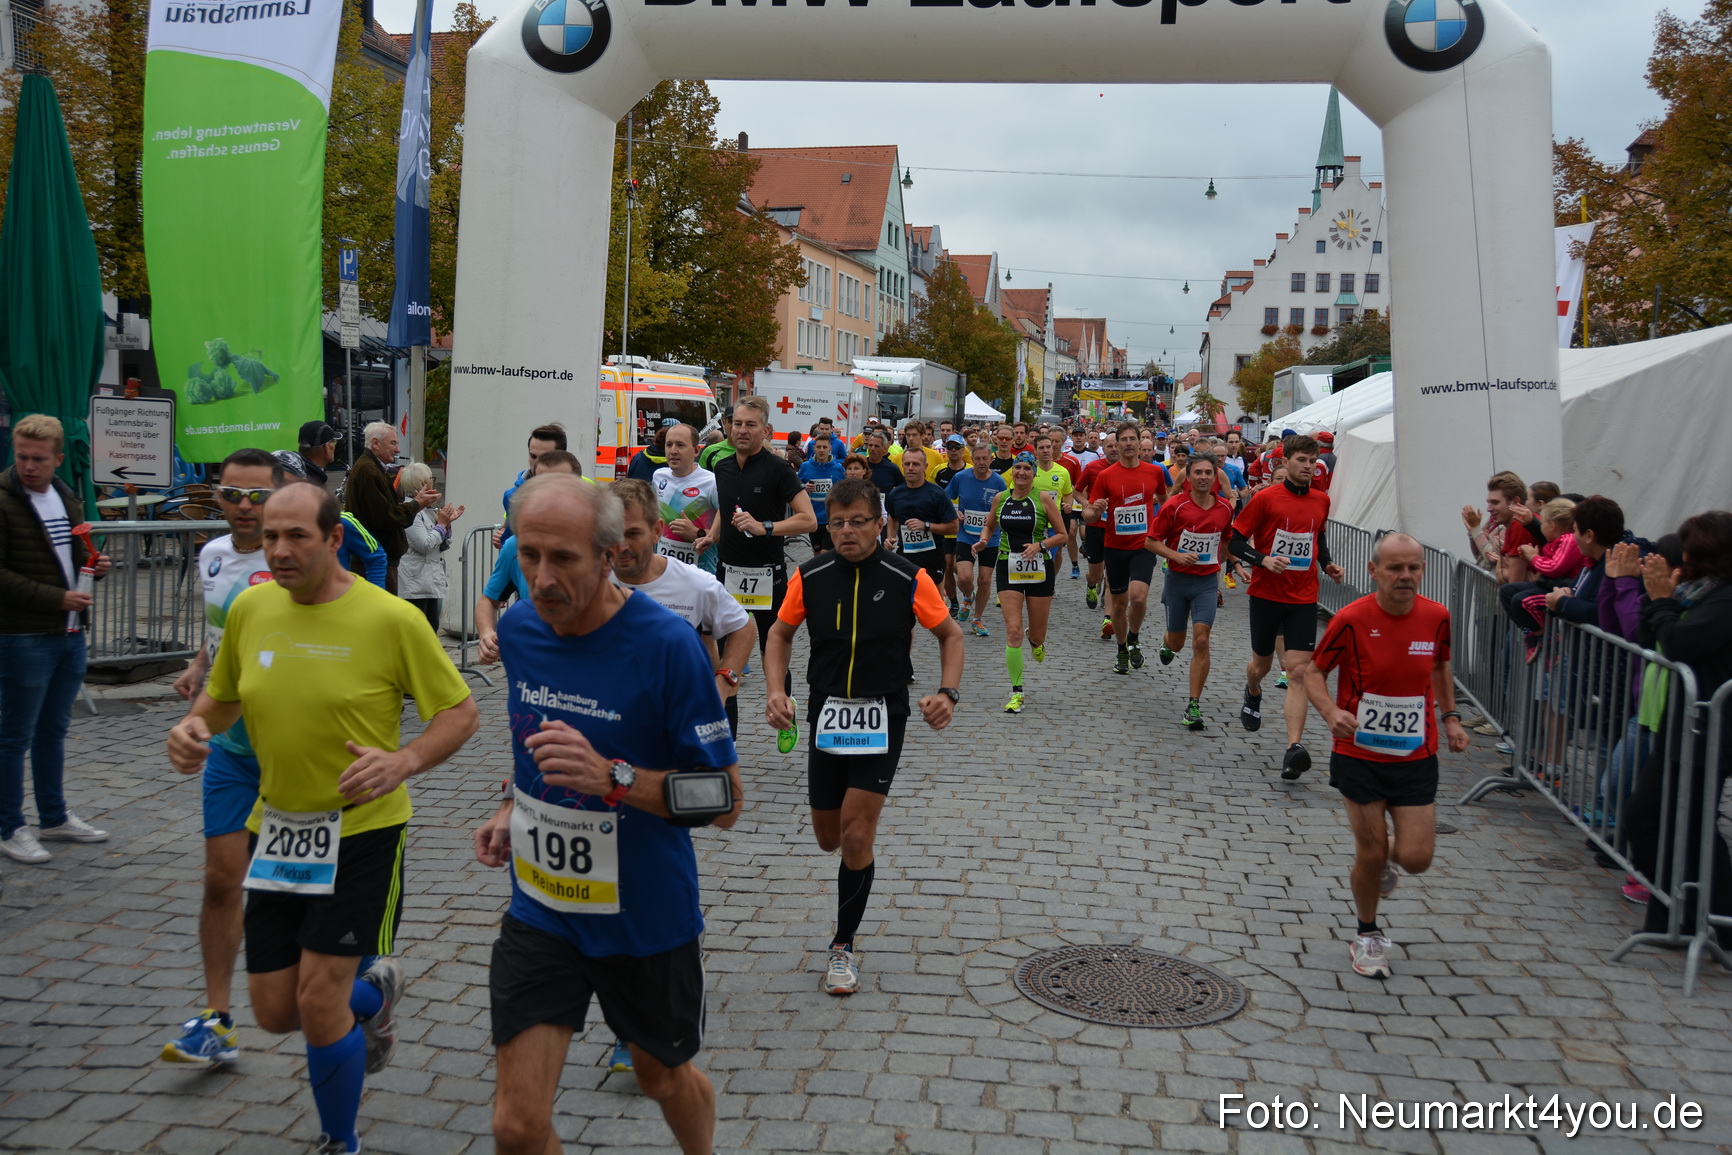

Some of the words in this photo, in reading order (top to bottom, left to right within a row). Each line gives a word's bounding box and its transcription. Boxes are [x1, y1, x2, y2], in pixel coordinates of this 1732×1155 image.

[343, 249, 354, 276] P
[453, 363, 574, 381] www.bmw-laufsport.de
[1420, 377, 1557, 395] www.bmw-laufsport.de
[796, 396, 829, 405] Bayerisches
[96, 406, 135, 418] Fußgänger
[137, 408, 170, 420] Richtung
[108, 417, 157, 428] Lammsbräu-
[105, 429, 141, 439] Kreuzung
[142, 430, 160, 439] über
[120, 440, 146, 449] Untere
[109, 450, 157, 461] Kaserngasse
[814, 483, 831, 493] 023
[1117, 511, 1145, 525] 2610
[904, 531, 930, 543] 2654
[1181, 538, 1211, 553] 2231
[1276, 540, 1311, 557] 2138
[1016, 560, 1039, 572] 370
[739, 578, 759, 594] 47
[741, 596, 755, 605] Lars
[1408, 641, 1434, 651] JURA
[520, 682, 558, 708] hella
[557, 690, 599, 708] hamburg
[557, 700, 622, 721] halbmarathon
[1384, 701, 1416, 709] Neumarkt
[823, 706, 881, 731] 2040
[1363, 708, 1420, 734] 2432
[833, 735, 870, 746] Michael
[1372, 736, 1407, 748] Herbert
[540, 813, 594, 832] Neumarkt
[265, 824, 331, 859] 2089
[527, 826, 593, 875] 198
[271, 865, 312, 881] Markus
[532, 869, 590, 900] Reinhold
